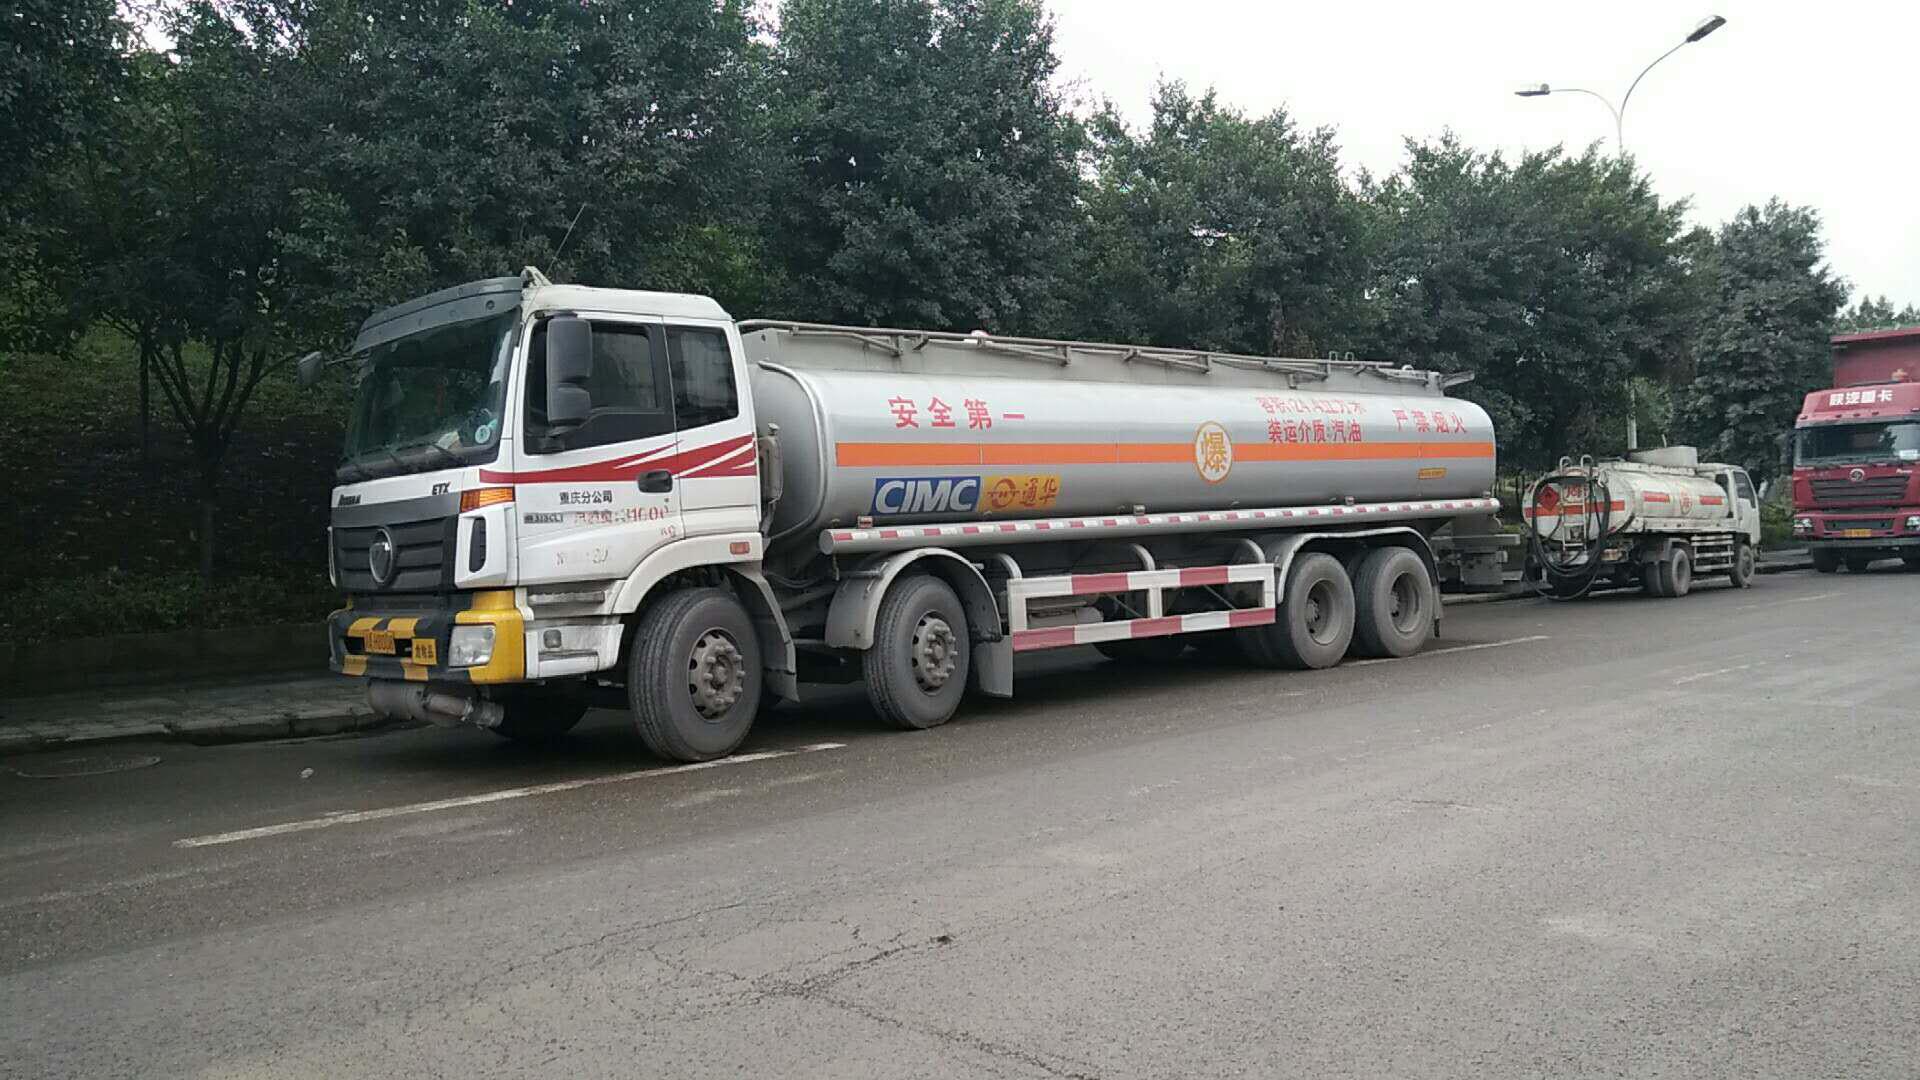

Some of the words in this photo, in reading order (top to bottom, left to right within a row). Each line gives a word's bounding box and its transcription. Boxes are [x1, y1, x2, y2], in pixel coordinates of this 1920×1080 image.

[888, 396, 1025, 430] 安全第一
[1392, 409, 1468, 434] 严禁烟火
[1202, 431, 1228, 474] 爆
[431, 482, 451, 496] ETX
[559, 489, 613, 505] 重庆分公司
[875, 478, 977, 514] CIMC
[1020, 477, 1058, 507] 通华
